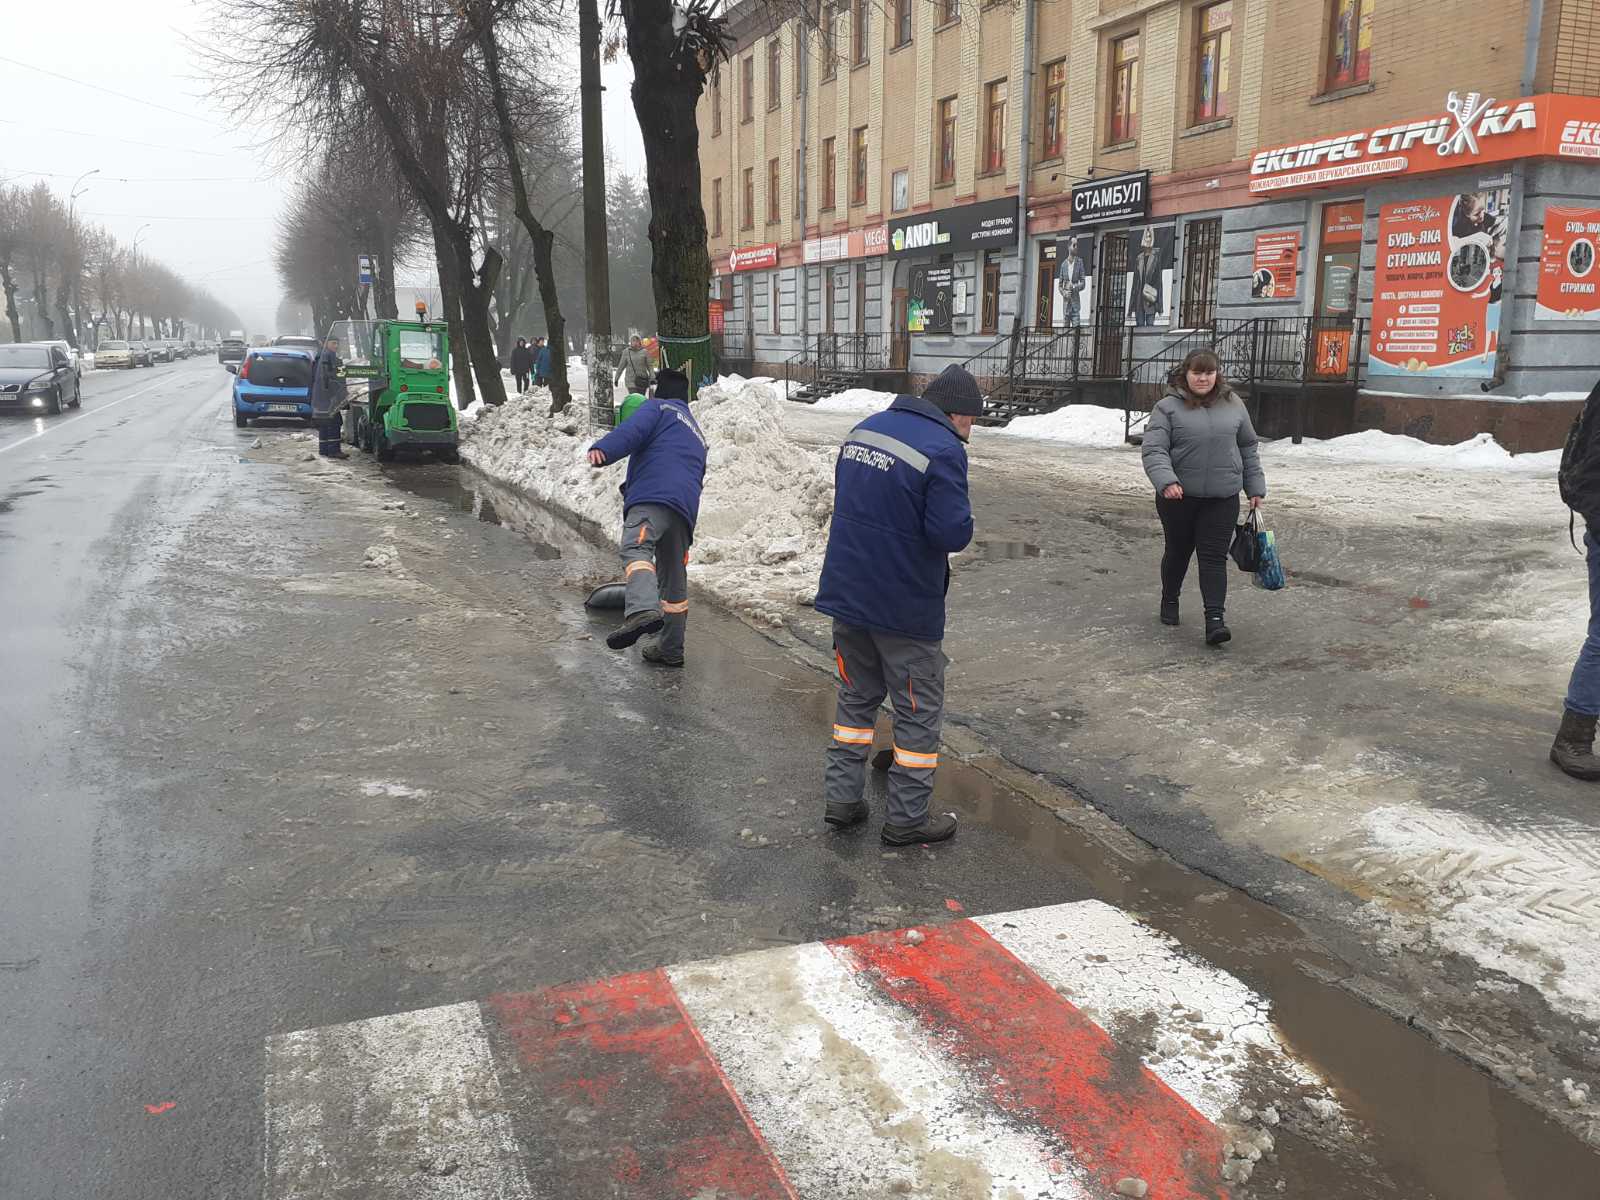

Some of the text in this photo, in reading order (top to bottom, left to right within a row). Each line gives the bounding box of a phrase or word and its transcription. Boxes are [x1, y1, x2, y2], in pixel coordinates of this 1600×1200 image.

[1251, 132, 1368, 175] ЕКСПРЕС
[1290, 170, 1317, 185] МЕРЕЖА
[1075, 182, 1141, 212] СТАМБУЛ
[905, 221, 939, 250] ANDI
[1388, 229, 1441, 248] БУДЬ-ЯКА
[1387, 250, 1441, 268] СТРИЖКА
[1560, 282, 1595, 294] СТРИЖКА
